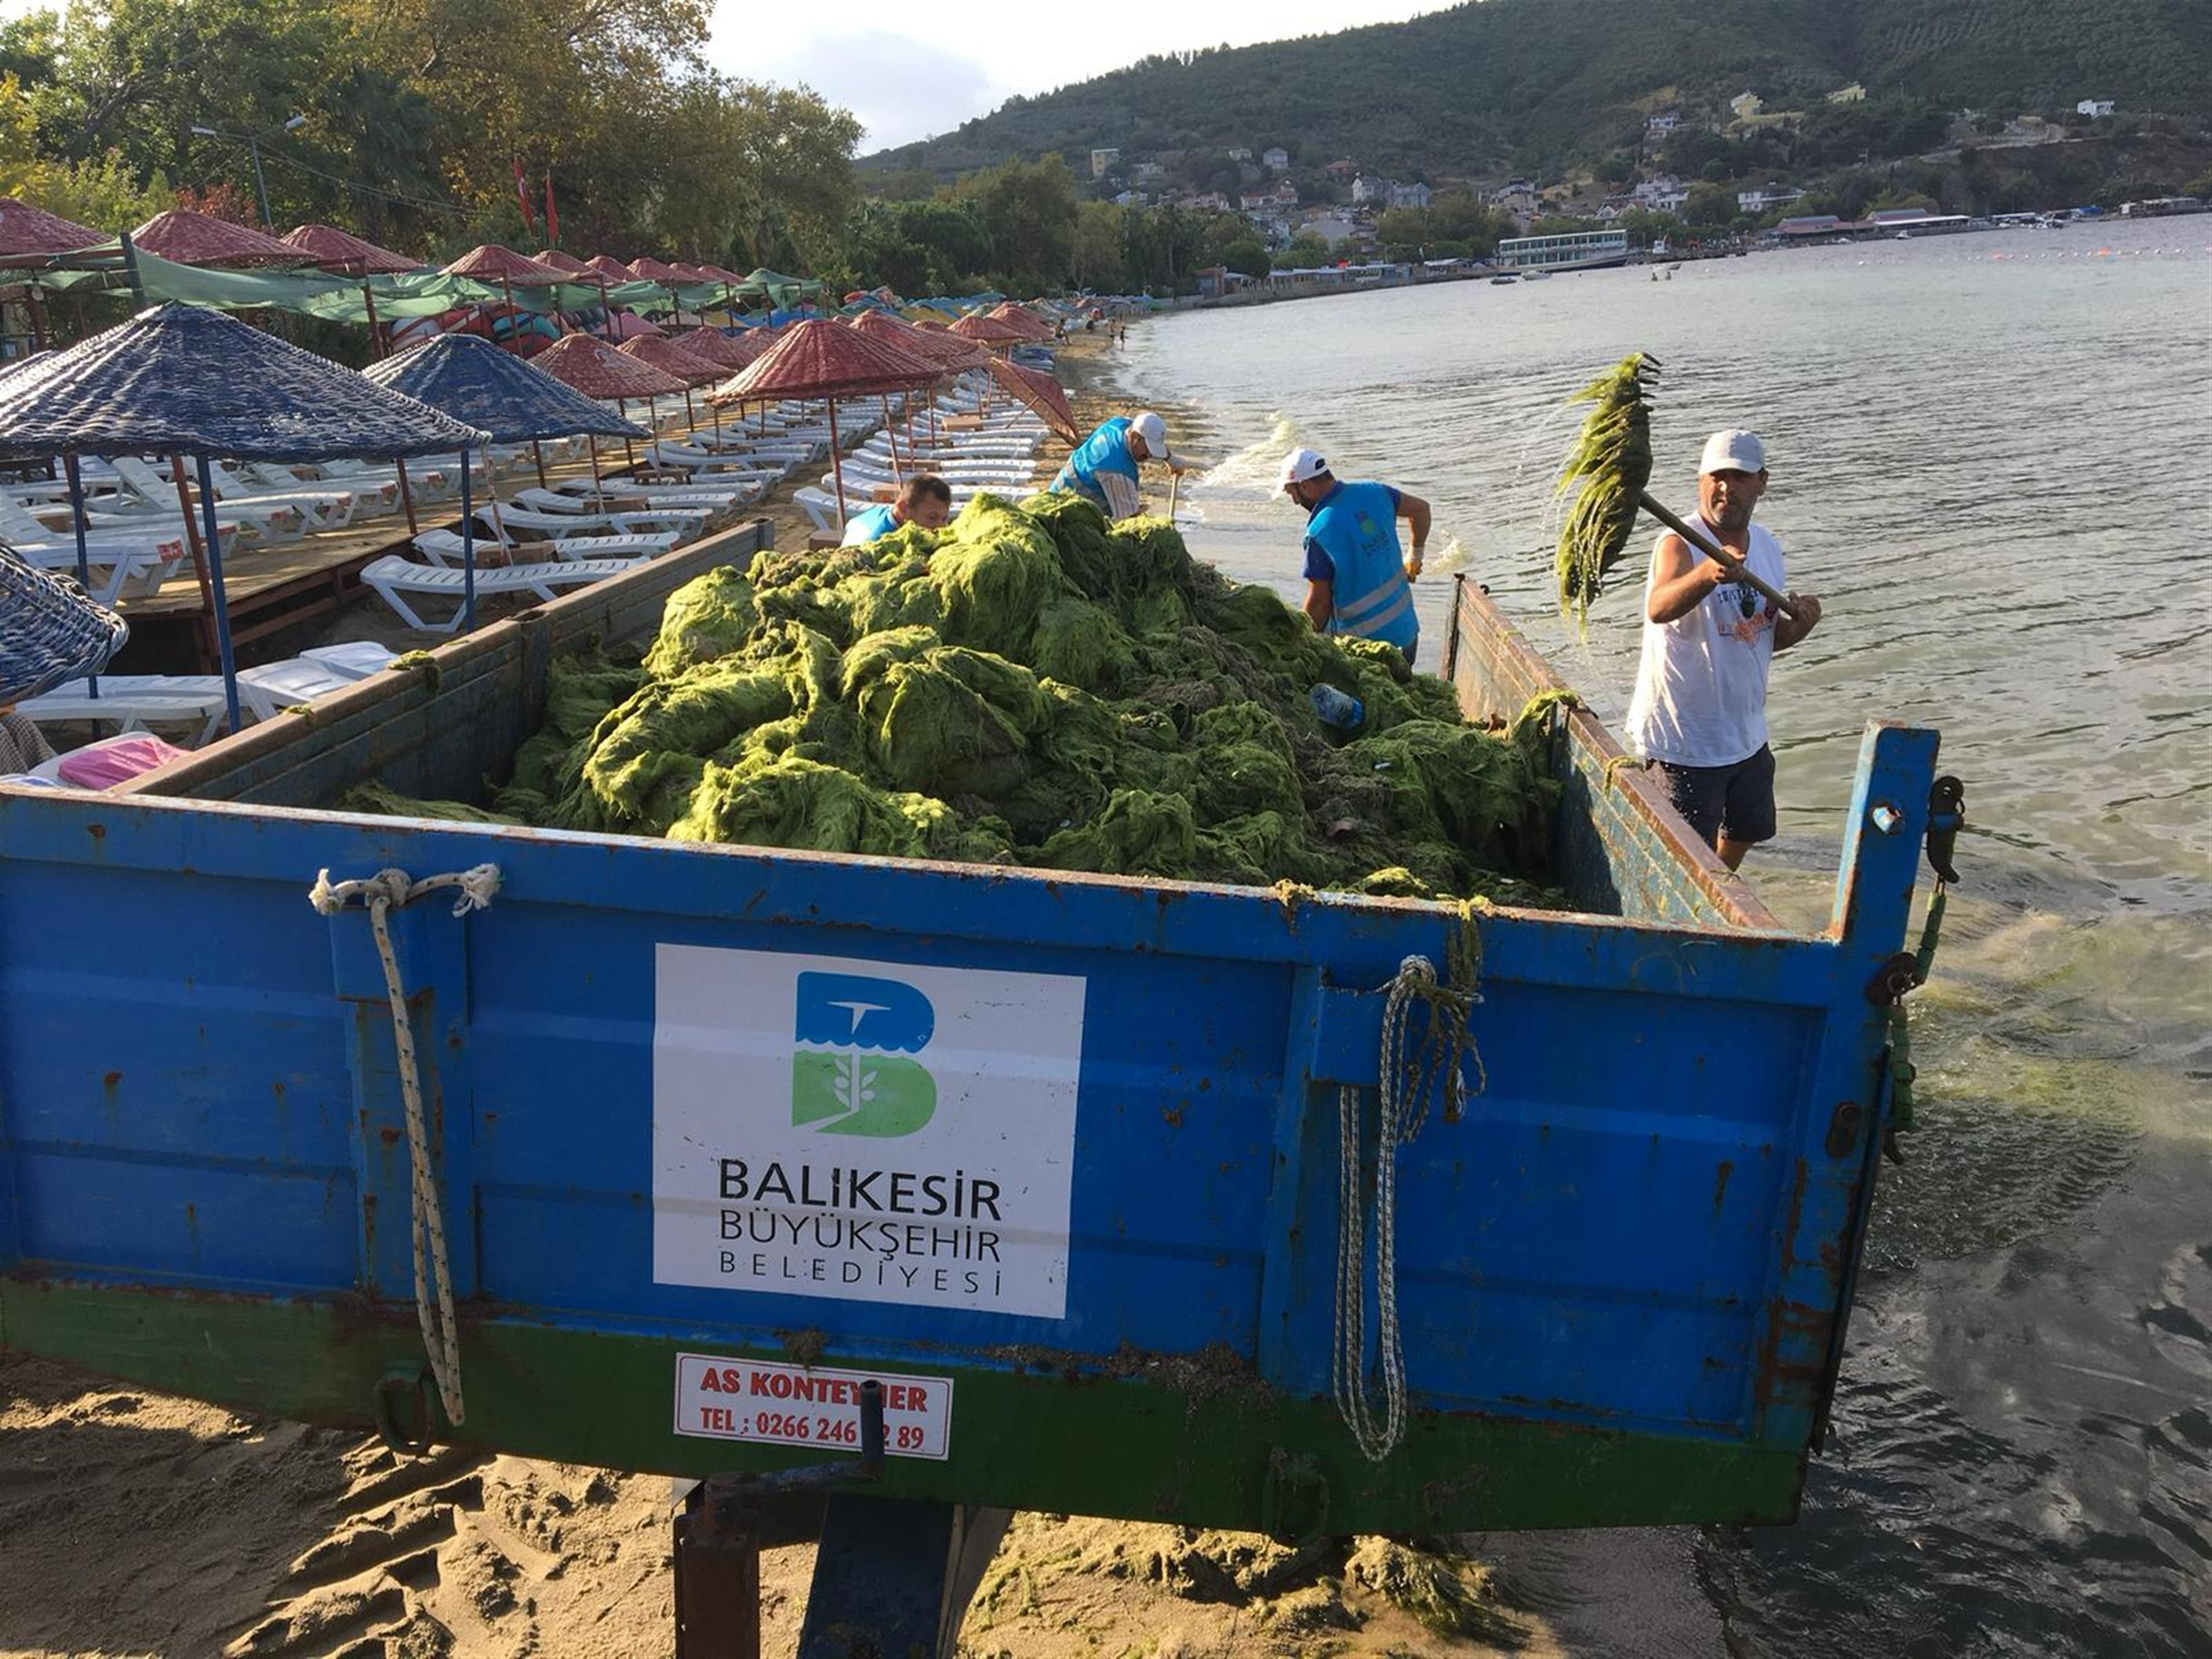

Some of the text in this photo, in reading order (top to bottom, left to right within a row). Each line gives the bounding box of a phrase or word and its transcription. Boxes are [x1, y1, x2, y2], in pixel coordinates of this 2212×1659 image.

[719, 1158, 1002, 1221] BALIKESİR
[719, 1207, 1000, 1263] BÜYÜKŞEHİR
[719, 1251, 1002, 1297] BELEDİYESİ
[700, 1367, 928, 1413] AS KONTEYER
[700, 1407, 736, 1431] TEL
[755, 1412, 810, 1438] 0266
[817, 1418, 857, 1443] 246
[897, 1425, 925, 1449] 89
